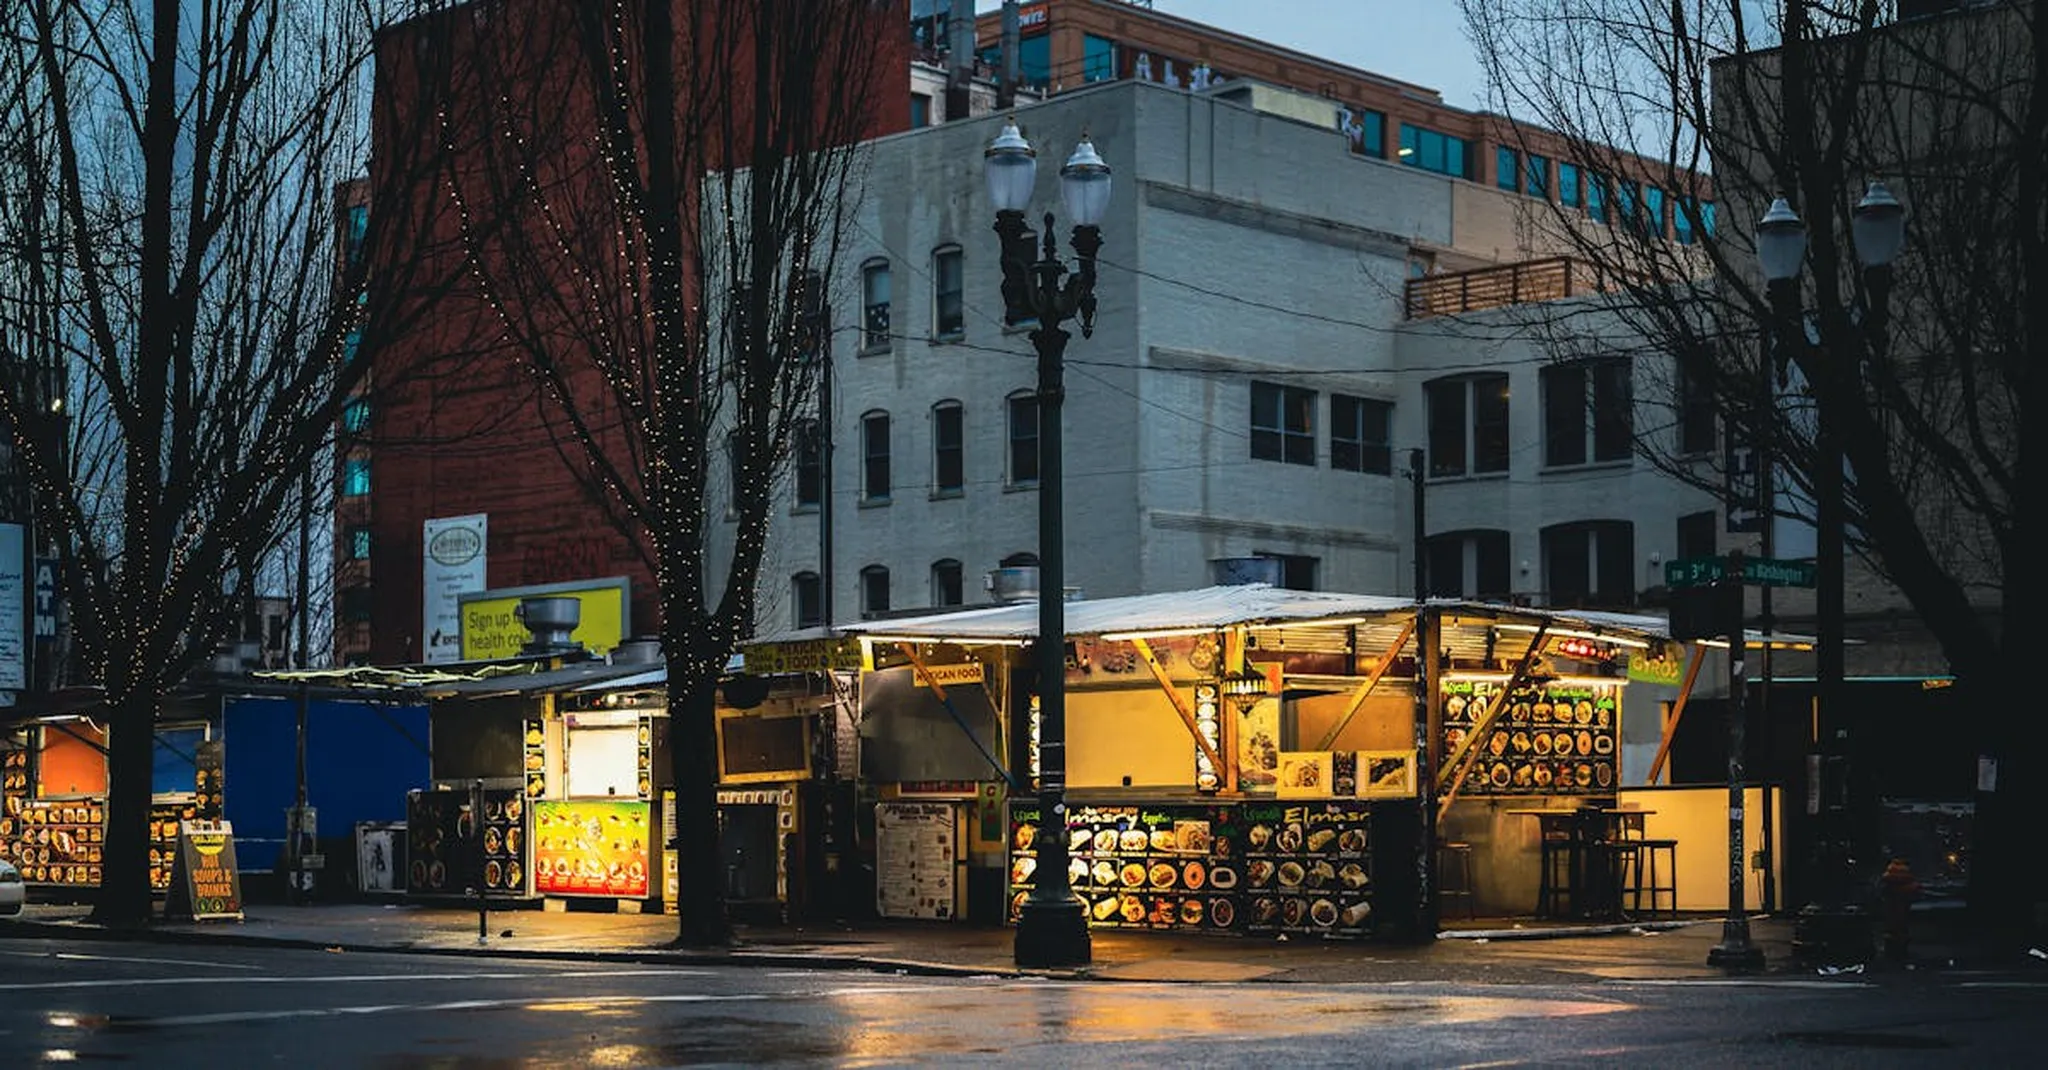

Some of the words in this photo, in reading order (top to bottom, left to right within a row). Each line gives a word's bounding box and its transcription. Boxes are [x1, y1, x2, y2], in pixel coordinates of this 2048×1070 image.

[37, 564, 56, 637] ATM
[469, 611, 493, 631] Sign
[495, 613, 510, 629] up
[469, 632, 504, 650] health
[788, 655, 819, 670] FOOD
[1632, 655, 1679, 679] GYROS
[193, 869, 223, 883] SOUPS
[197, 883, 232, 897] DRINKS
